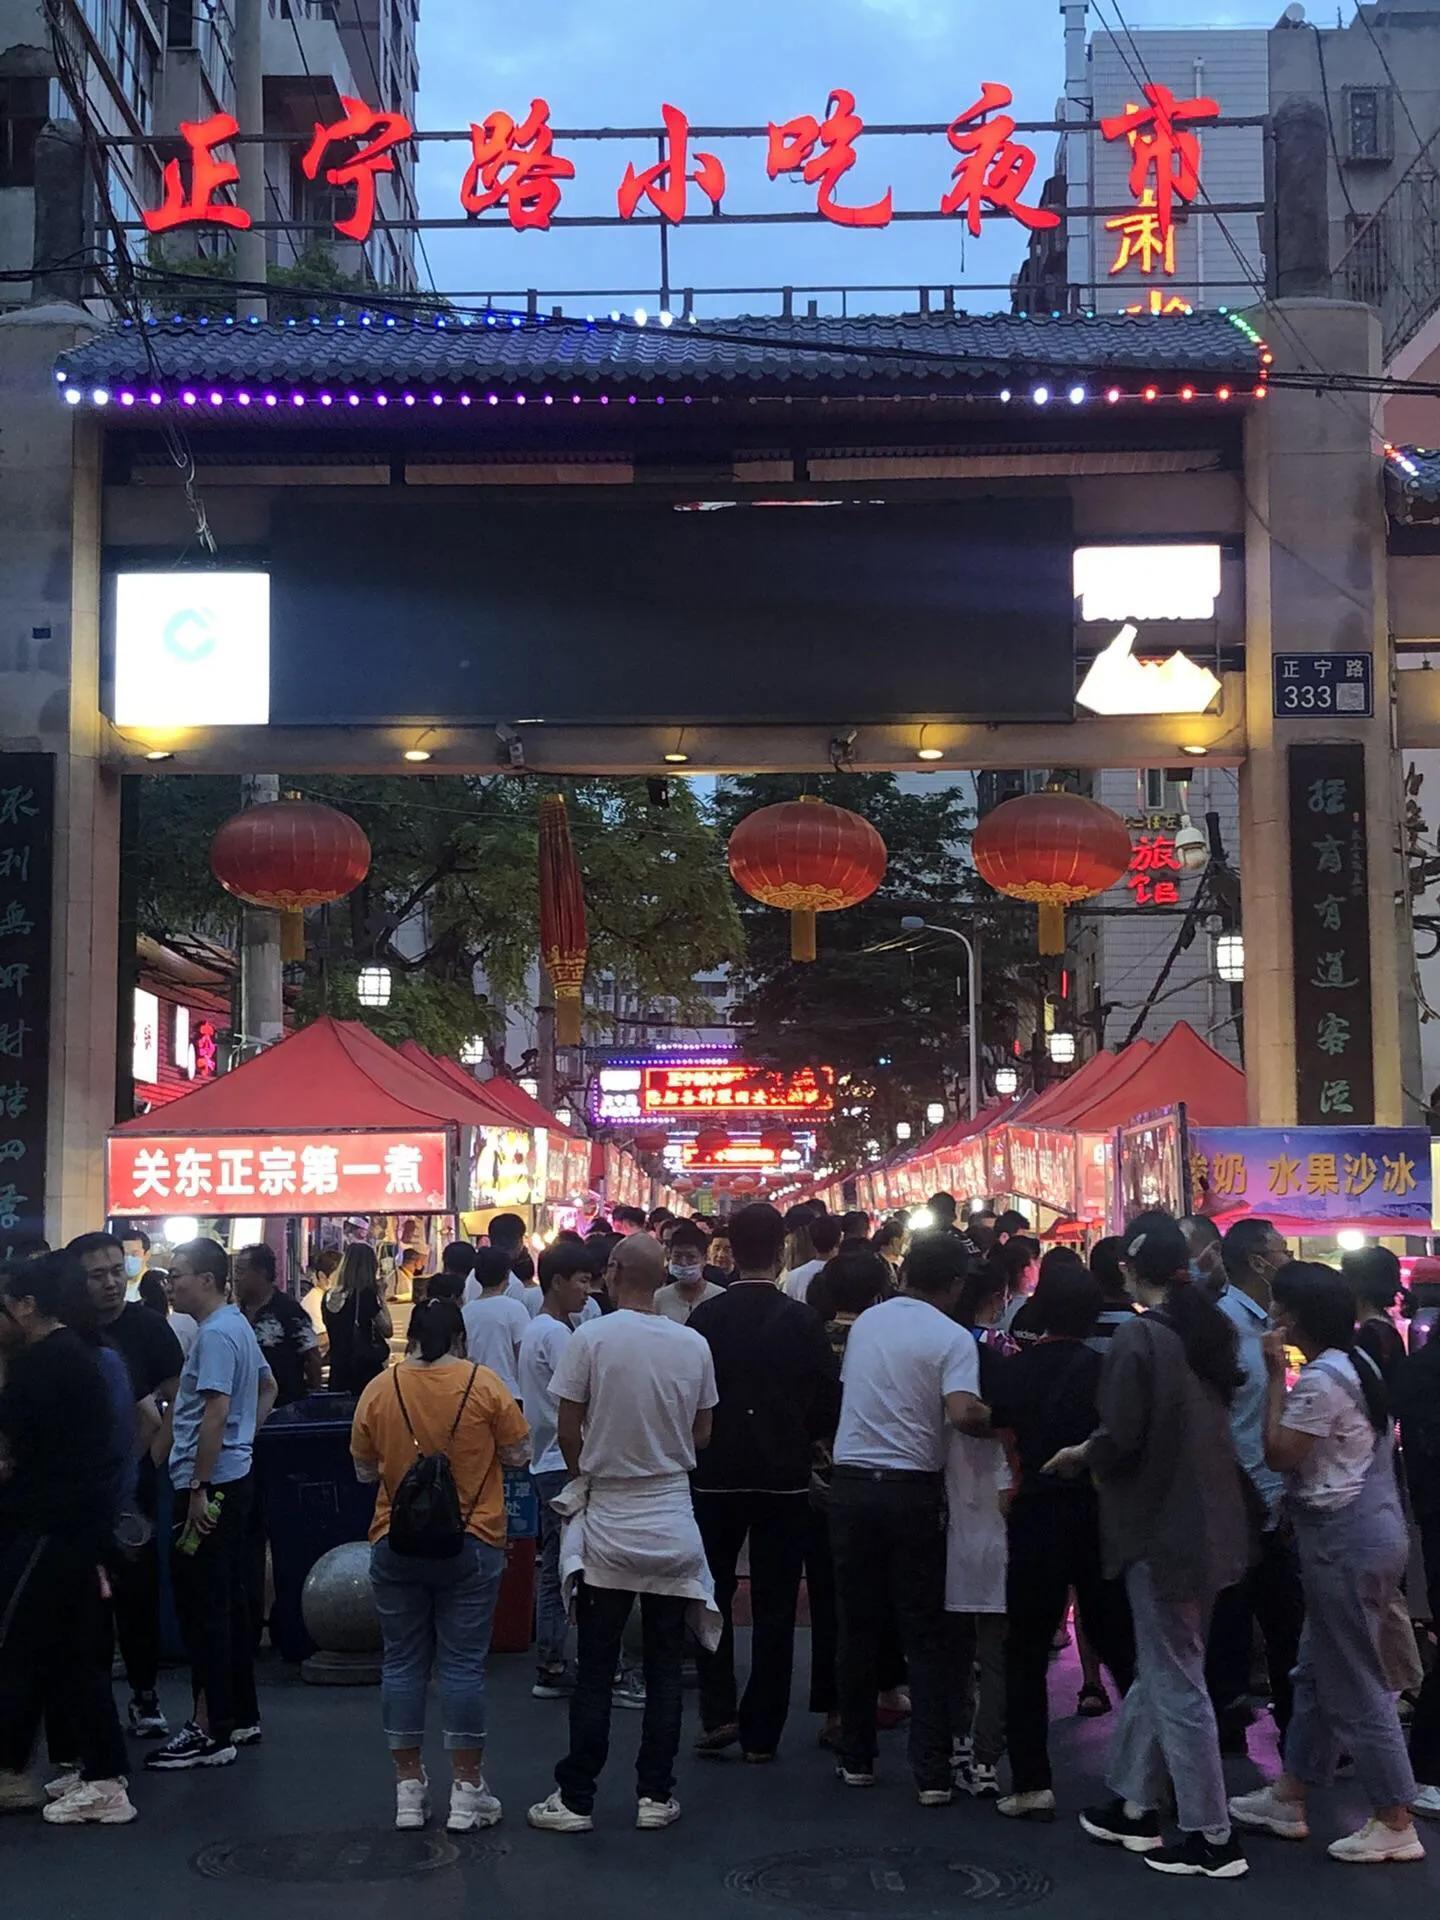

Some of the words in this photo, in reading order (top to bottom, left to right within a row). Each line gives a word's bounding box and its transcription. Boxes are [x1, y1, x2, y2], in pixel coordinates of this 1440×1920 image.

[144, 83, 1220, 241] 正宁路小吃夜市
[1282, 659, 1364, 679] 正宁路
[1284, 685, 1332, 708] 333
[1127, 834, 1182, 905] 旅馆
[131, 1144, 424, 1198] 关东正宗第一煮
[1266, 1151, 1418, 1196] 水果沙冰
